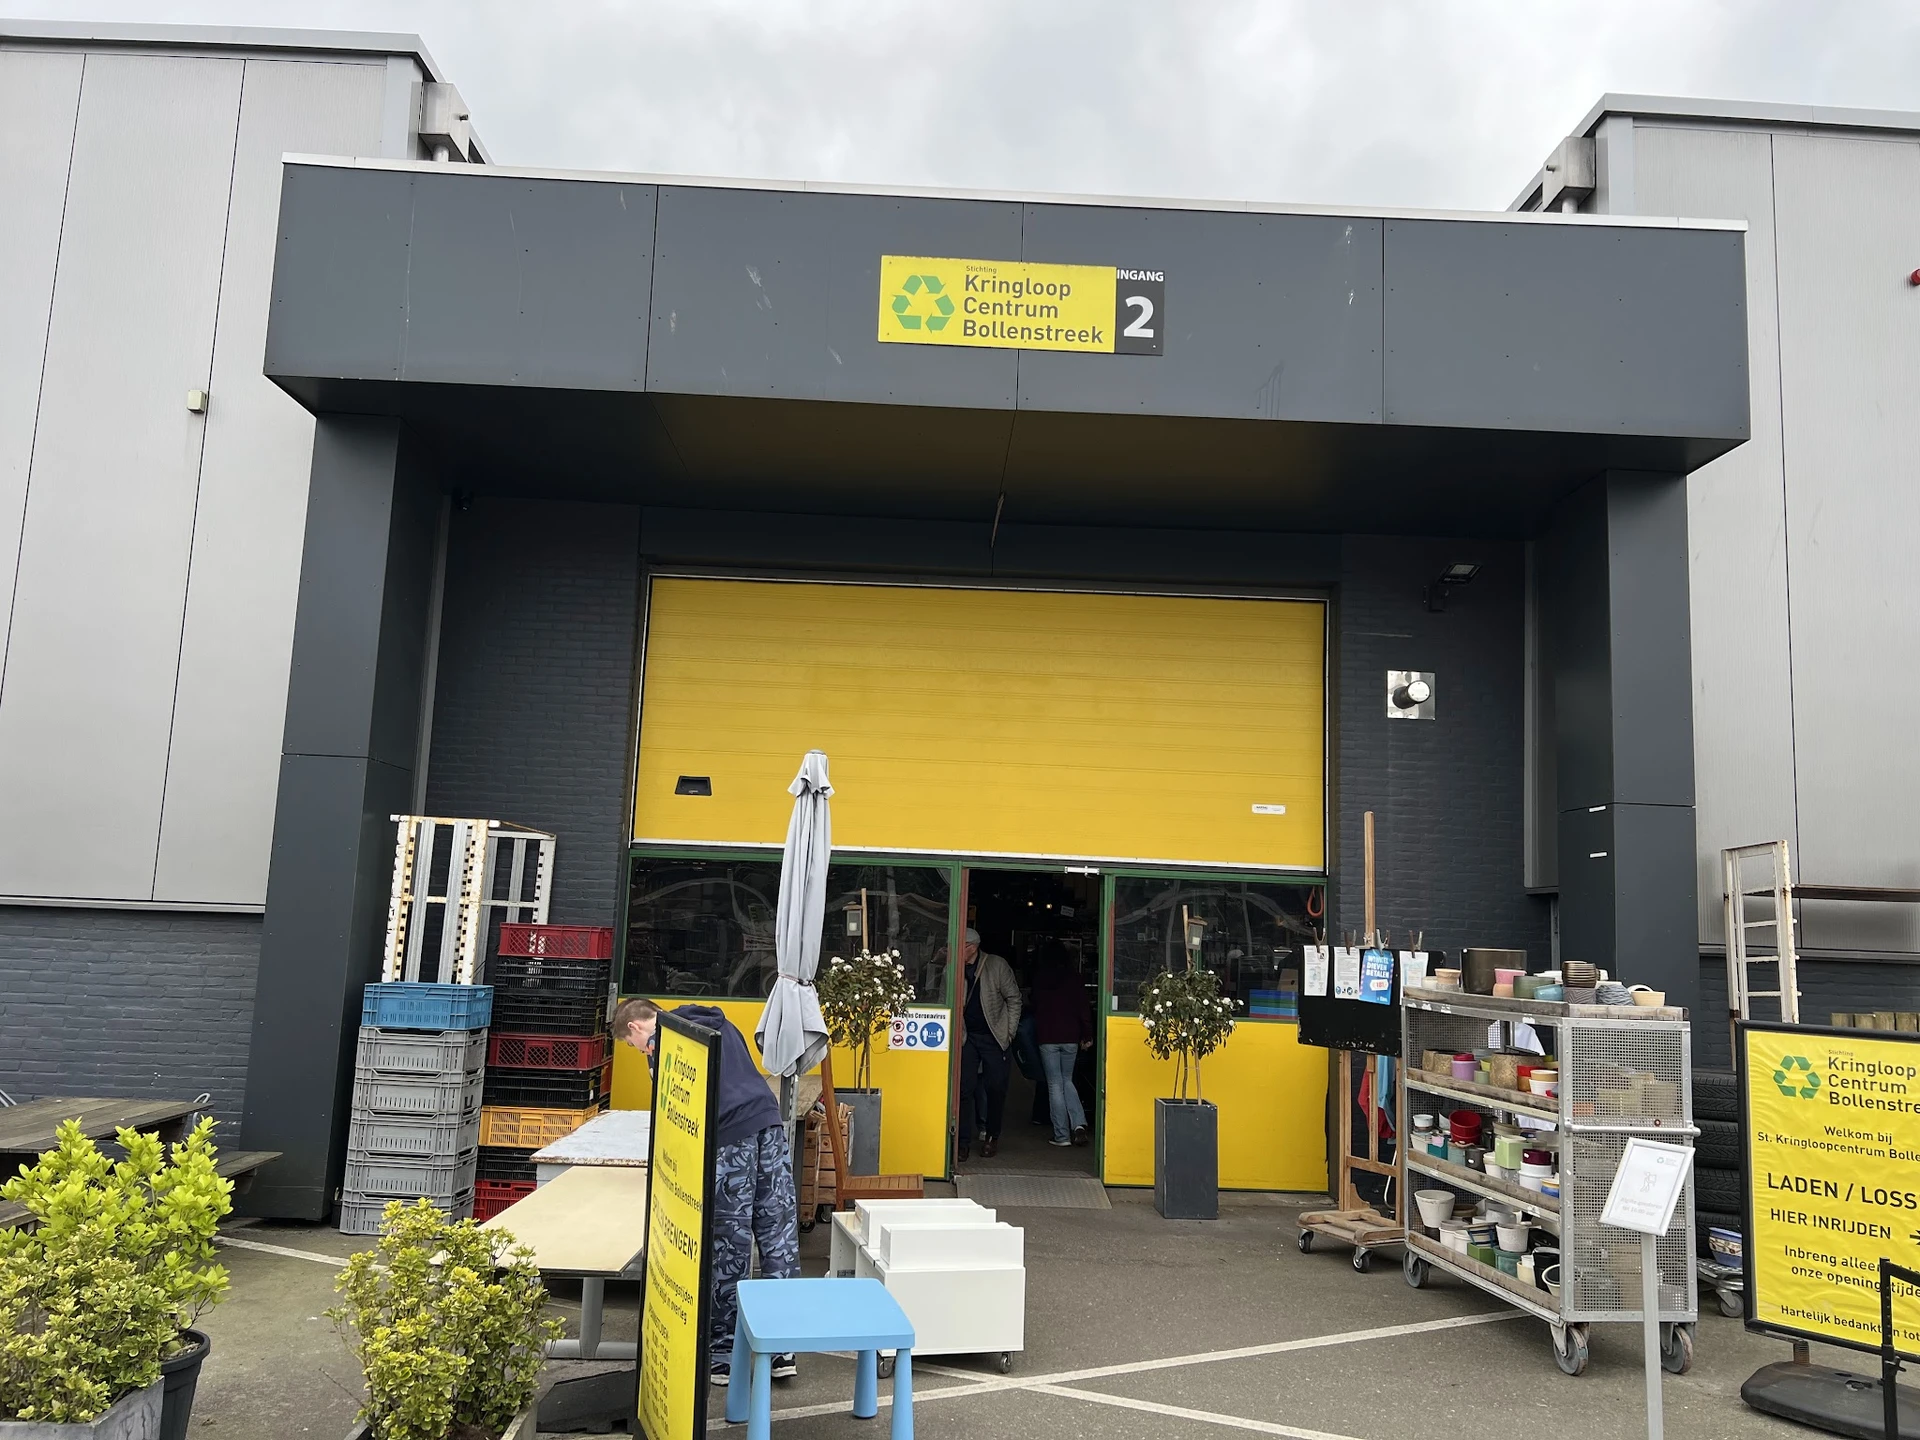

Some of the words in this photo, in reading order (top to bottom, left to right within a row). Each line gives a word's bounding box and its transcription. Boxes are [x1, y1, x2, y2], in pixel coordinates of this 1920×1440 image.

[966, 265, 997, 274] Stichting
[1116, 269, 1164, 282] INGANG
[964, 274, 1071, 300] Kringloop
[963, 297, 1058, 319] Centrum
[1123, 296, 1155, 338] 2
[963, 319, 1103, 344] Bollenstreek
[915, 1012, 946, 1020] Coronavirus
[673, 1054, 697, 1087] Kringloop
[1828, 1056, 1916, 1080] Kringloop
[670, 1077, 690, 1107] Centrum
[1829, 1073, 1907, 1095] Centrum
[667, 1100, 700, 1140] Bollenstreek
[1757, 1131, 1773, 1143] St.
[1775, 1134, 1886, 1158] Kringloopcentrum
[1824, 1125, 1874, 1141] Welkom
[1877, 1132, 1892, 1146] bij
[1767, 1172, 1838, 1199] LADEN
[1845, 1182, 1854, 1202] /
[1861, 1186, 1918, 1210] LOSS
[1770, 1207, 1808, 1226] HIER
[1813, 1214, 1891, 1240] INRIJDEN
[1785, 1245, 1837, 1267] Inbreng
[1841, 1257, 1882, 1274] allee
[1791, 1266, 1823, 1280] onze
[1781, 1305, 1831, 1324] Hartelijk
[1834, 1315, 1883, 1335] bedankt
[1903, 1329, 1920, 1342] tot
